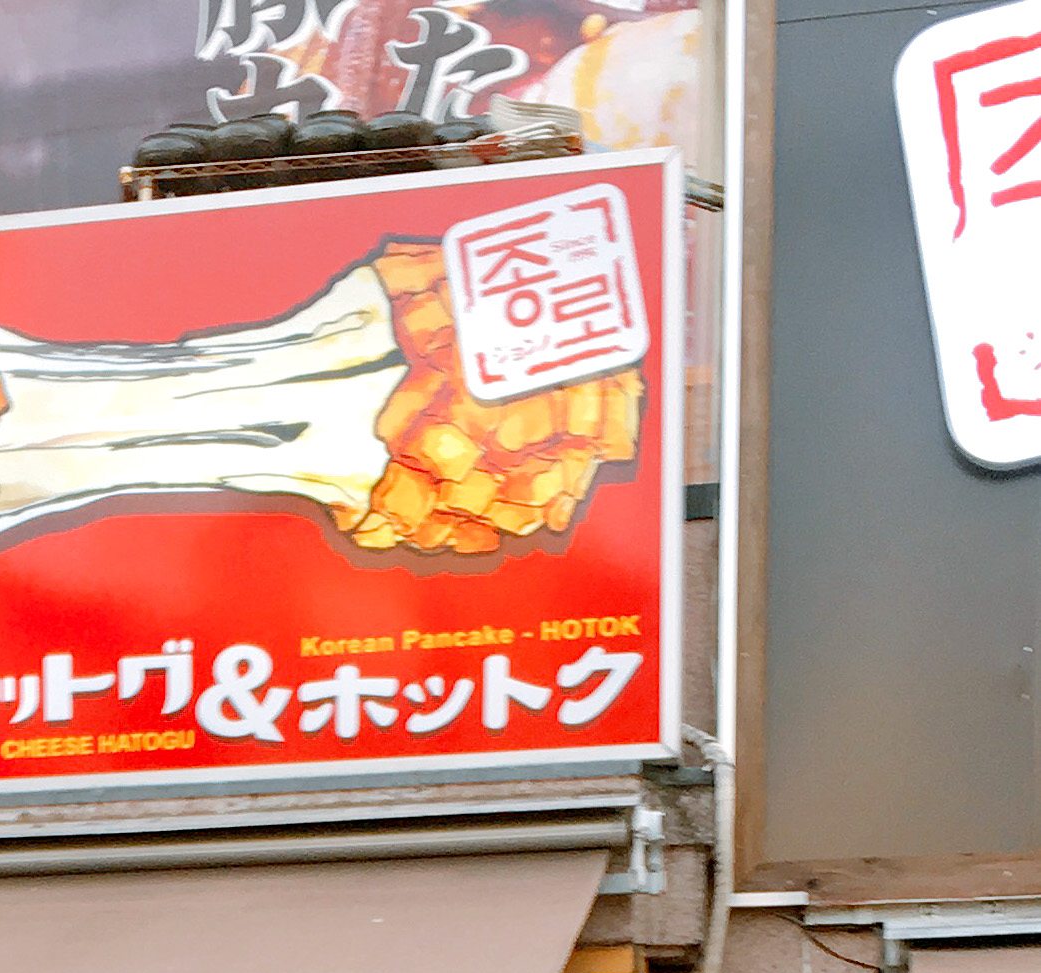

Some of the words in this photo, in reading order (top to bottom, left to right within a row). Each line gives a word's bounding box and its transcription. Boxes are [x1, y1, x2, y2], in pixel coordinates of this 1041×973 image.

[300, 636, 394, 657] Korean
[402, 626, 514, 650] Pancake
[540, 615, 642, 641] HOTOK
[1, 735, 94, 760] CHEESE
[97, 730, 195, 754] HATOGU
